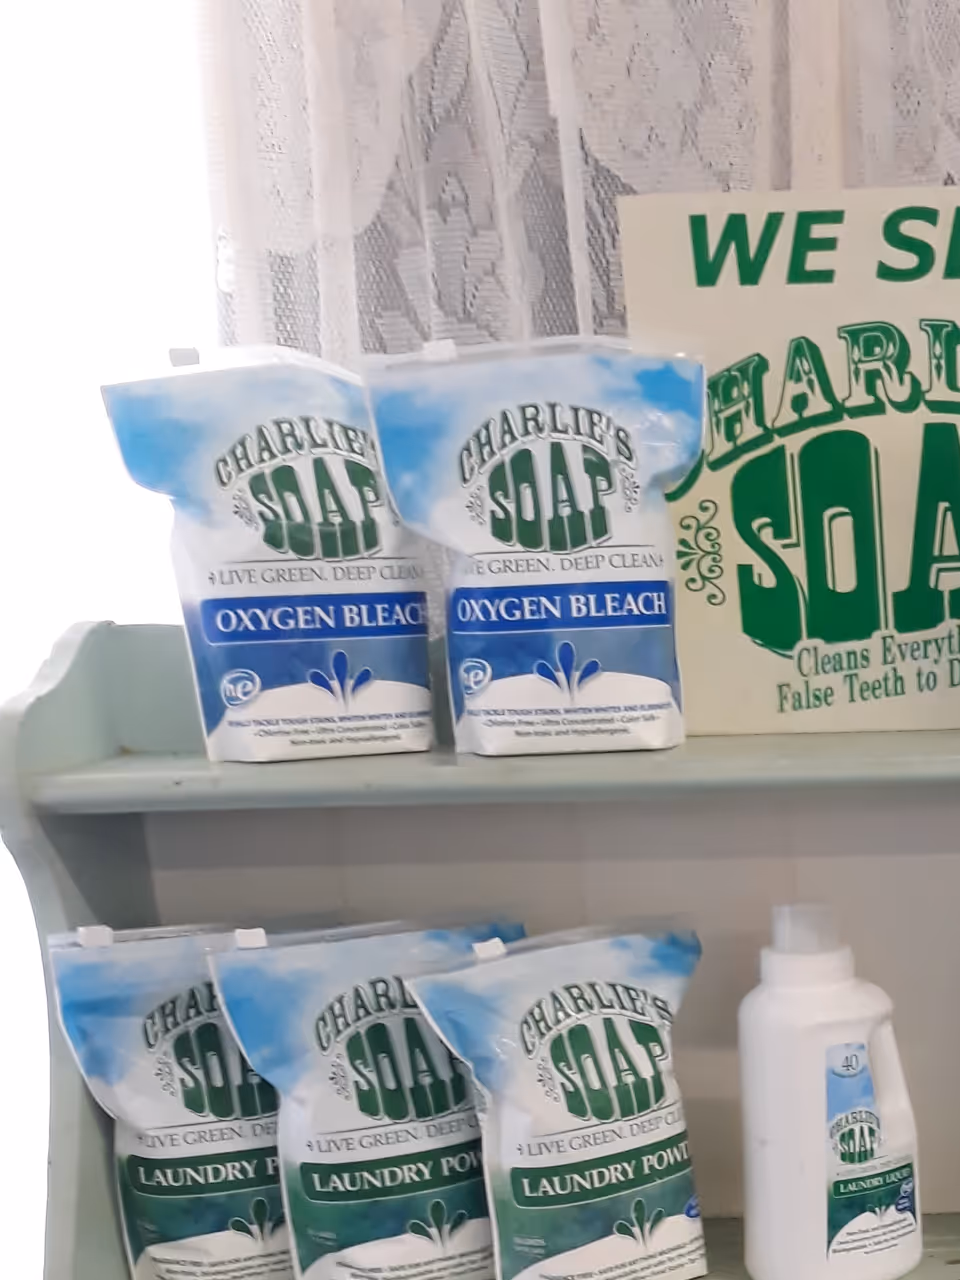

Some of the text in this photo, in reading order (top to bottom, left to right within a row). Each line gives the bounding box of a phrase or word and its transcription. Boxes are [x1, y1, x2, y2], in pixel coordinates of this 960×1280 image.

[688, 209, 845, 288] WE
[459, 402, 638, 488] CHARLIE'S
[249, 456, 384, 561] SOAP
[488, 441, 613, 554] SOAP
[219, 566, 257, 586] LIVE
[333, 565, 378, 581] DEEP
[560, 554, 607, 572] DEEP
[216, 605, 335, 632] OXYGEN
[457, 592, 667, 622] OXYGEN BLEACH
[795, 645, 870, 679] Cleans
[777, 678, 848, 714] False
[842, 670, 907, 703] Teeth
[917, 672, 937, 693] to
[315, 976, 422, 1054] CHARL
[520, 981, 674, 1060] CHARLIE'S
[549, 1017, 669, 1123] SOAP
[315, 1137, 354, 1154] LIVE
[527, 1137, 566, 1157] LIVE
[629, 1117, 663, 1137] DEEP
[138, 1159, 257, 1187] LAUNDRY
[312, 1162, 433, 1193] LAUNDRY
[523, 1159, 636, 1197] LAUNDRY
[840, 1177, 883, 1193] LAUNDRY
